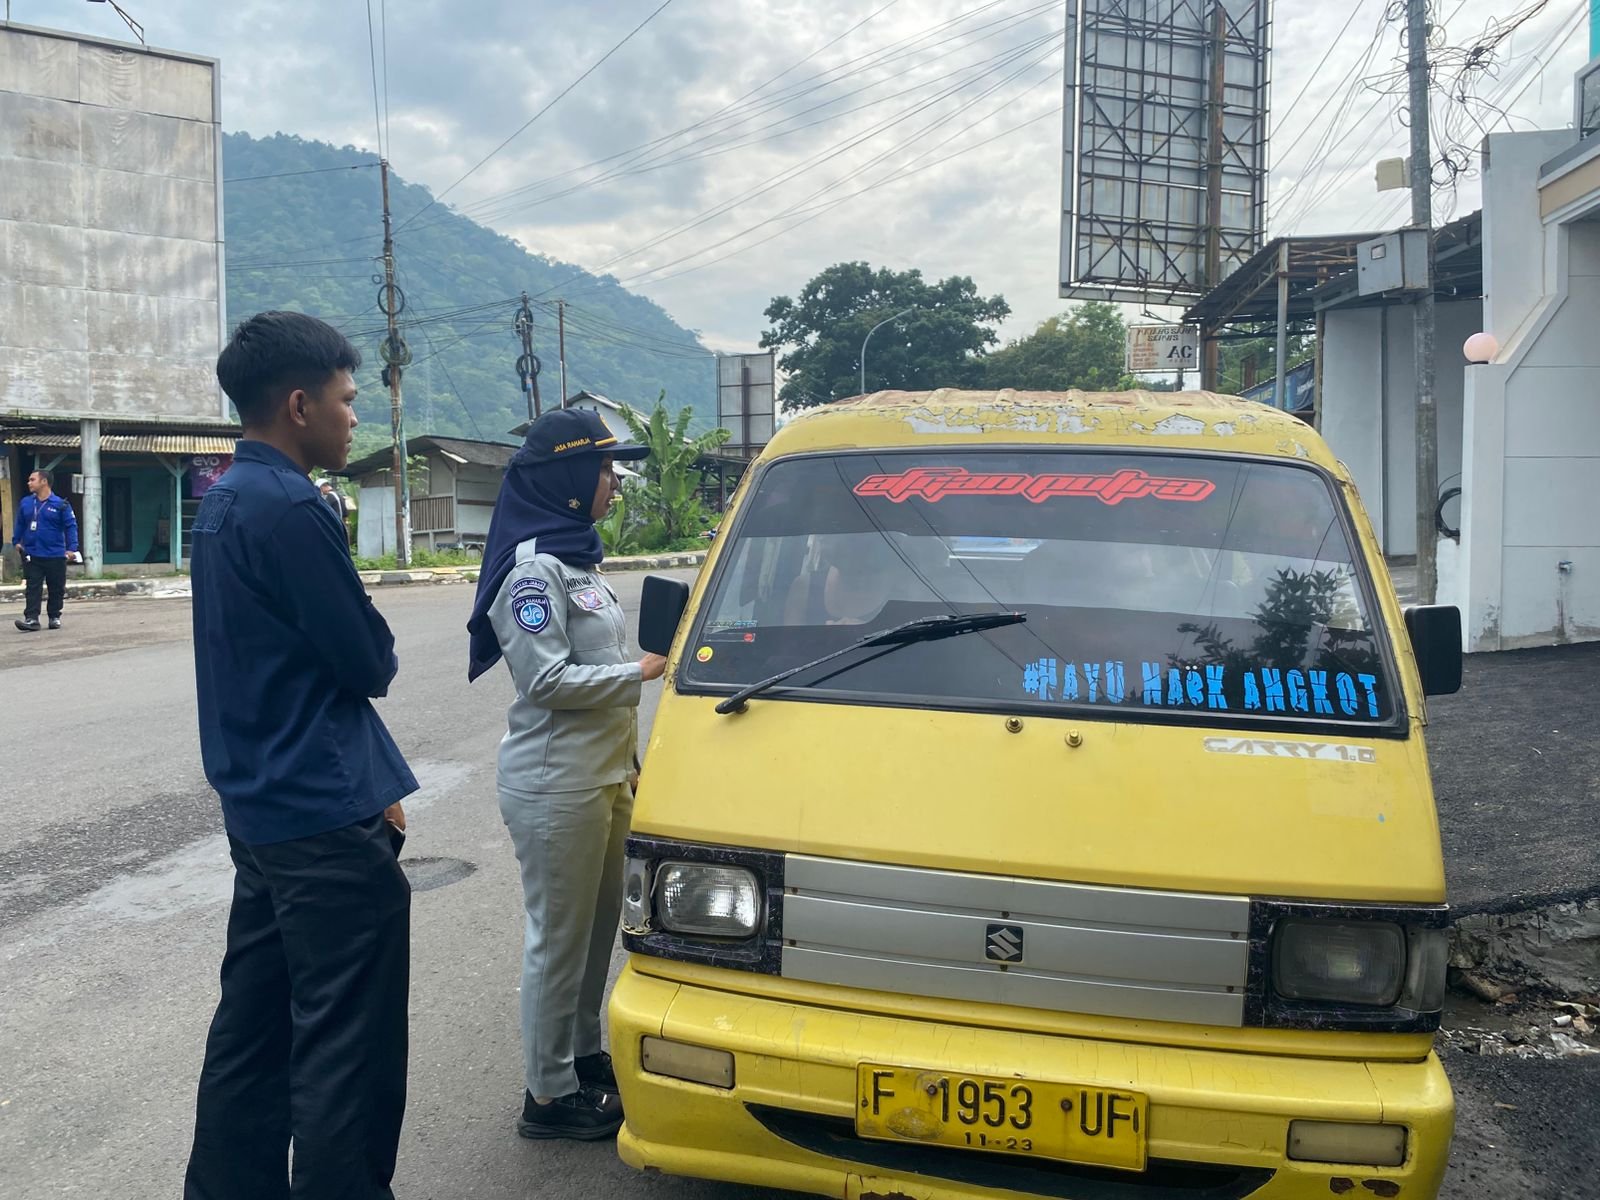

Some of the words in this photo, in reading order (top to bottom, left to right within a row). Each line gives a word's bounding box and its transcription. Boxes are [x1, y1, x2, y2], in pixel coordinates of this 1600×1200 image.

[1167, 345, 1192, 358] AC
[554, 443, 567, 452] JASA
[568, 438, 591, 447] RAHARJA
[192, 456, 220, 466] evo
[515, 600, 525, 608] JASA
[1244, 666, 1379, 717] ANGKOT
[1203, 737, 1327, 758] CARRY
[872, 1070, 895, 1115] F
[937, 1076, 1033, 1130] 1953
[1080, 1090, 1133, 1139] UF
